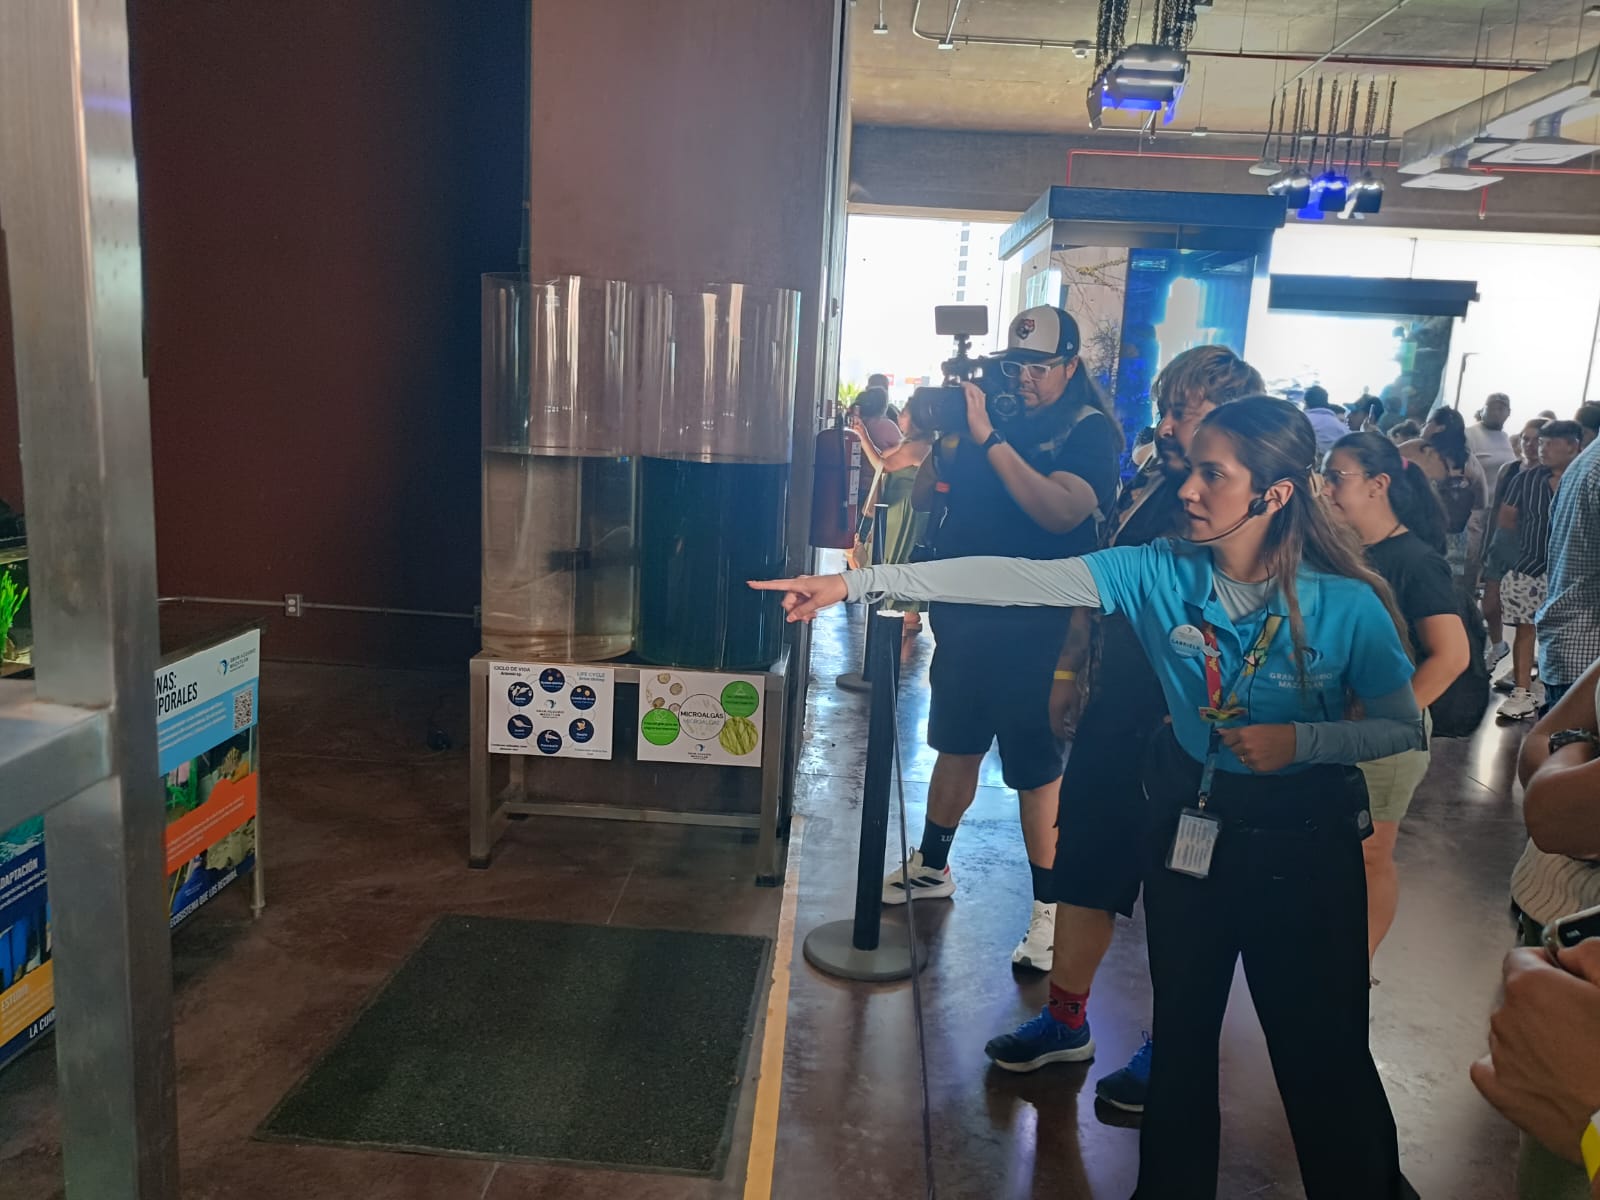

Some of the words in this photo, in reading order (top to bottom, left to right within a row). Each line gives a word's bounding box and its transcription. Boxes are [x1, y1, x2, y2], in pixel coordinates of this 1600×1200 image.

[156, 671, 177, 697] NAS:
[156, 681, 198, 716] PORALES
[680, 711, 724, 719] MICROALGAS
[0, 856, 38, 890] DAPTACIÓN
[29, 1023, 39, 1039] LA
